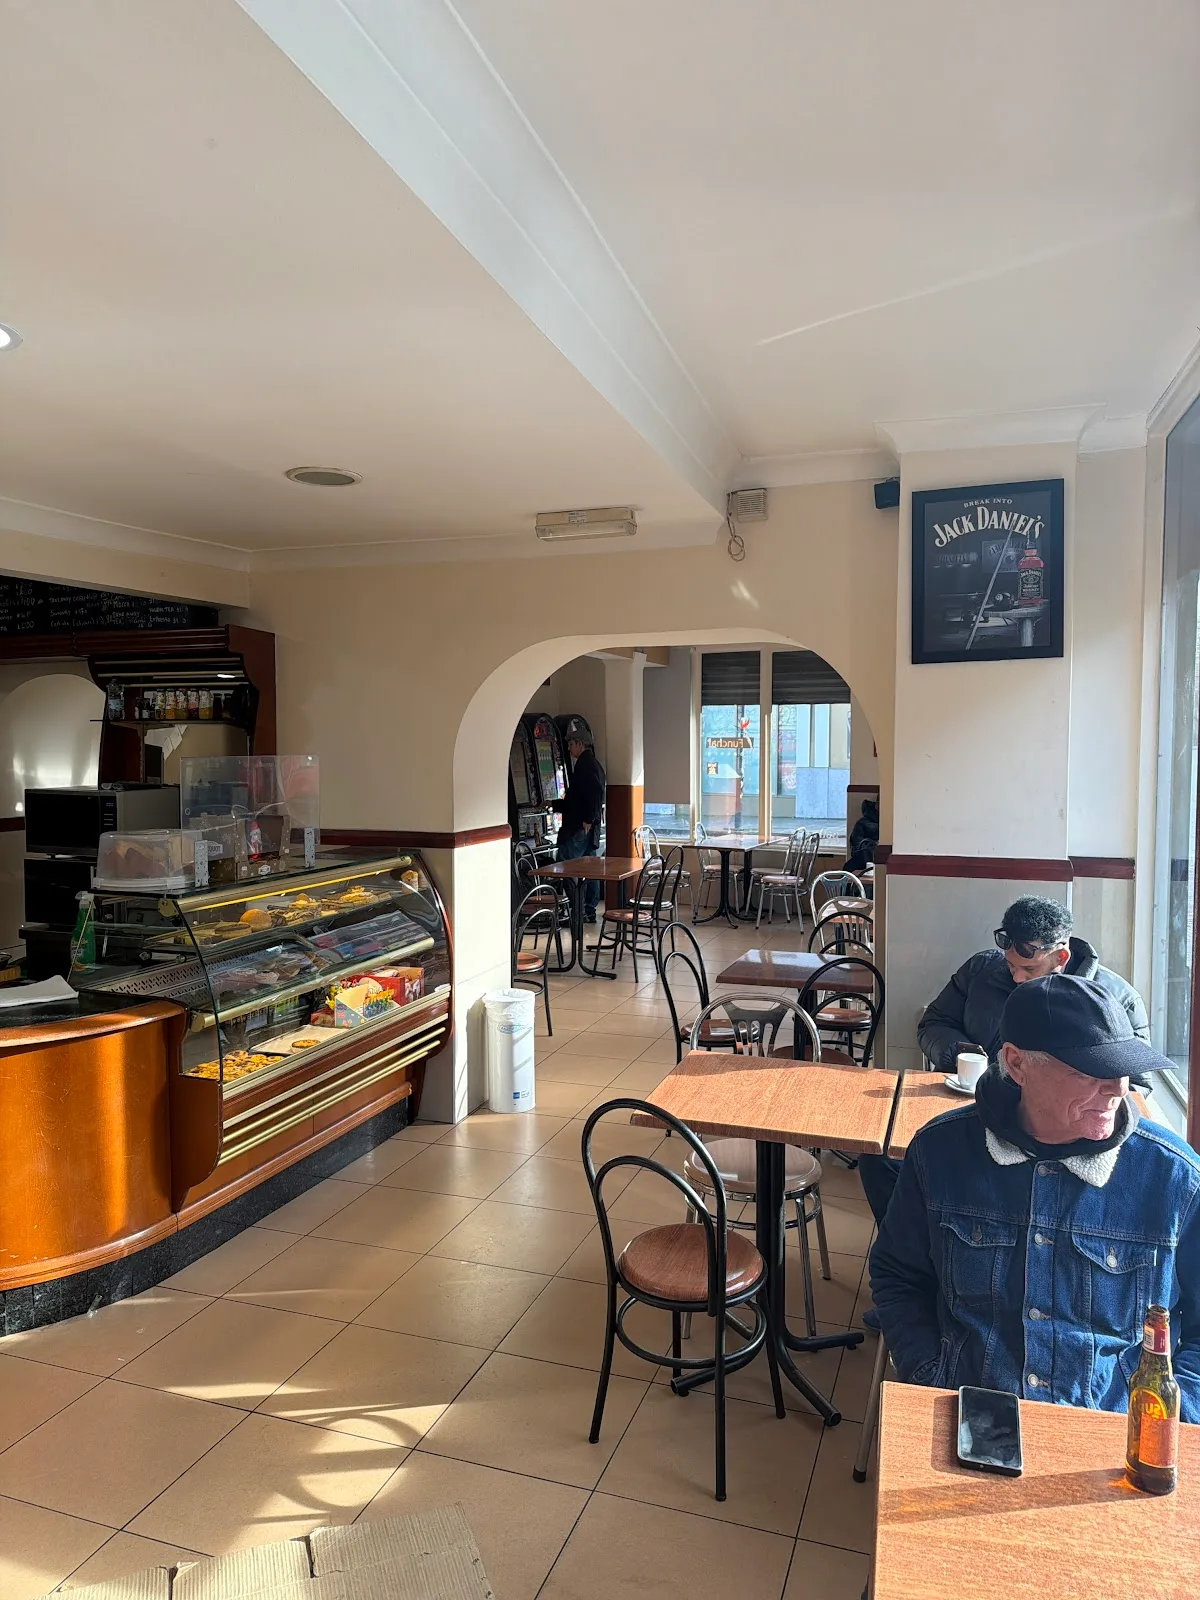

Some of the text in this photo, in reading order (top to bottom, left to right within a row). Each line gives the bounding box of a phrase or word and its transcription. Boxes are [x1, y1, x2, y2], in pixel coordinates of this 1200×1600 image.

[963, 498, 990, 508] BREAK
[933, 506, 1045, 548] JACK DANIEL'S
